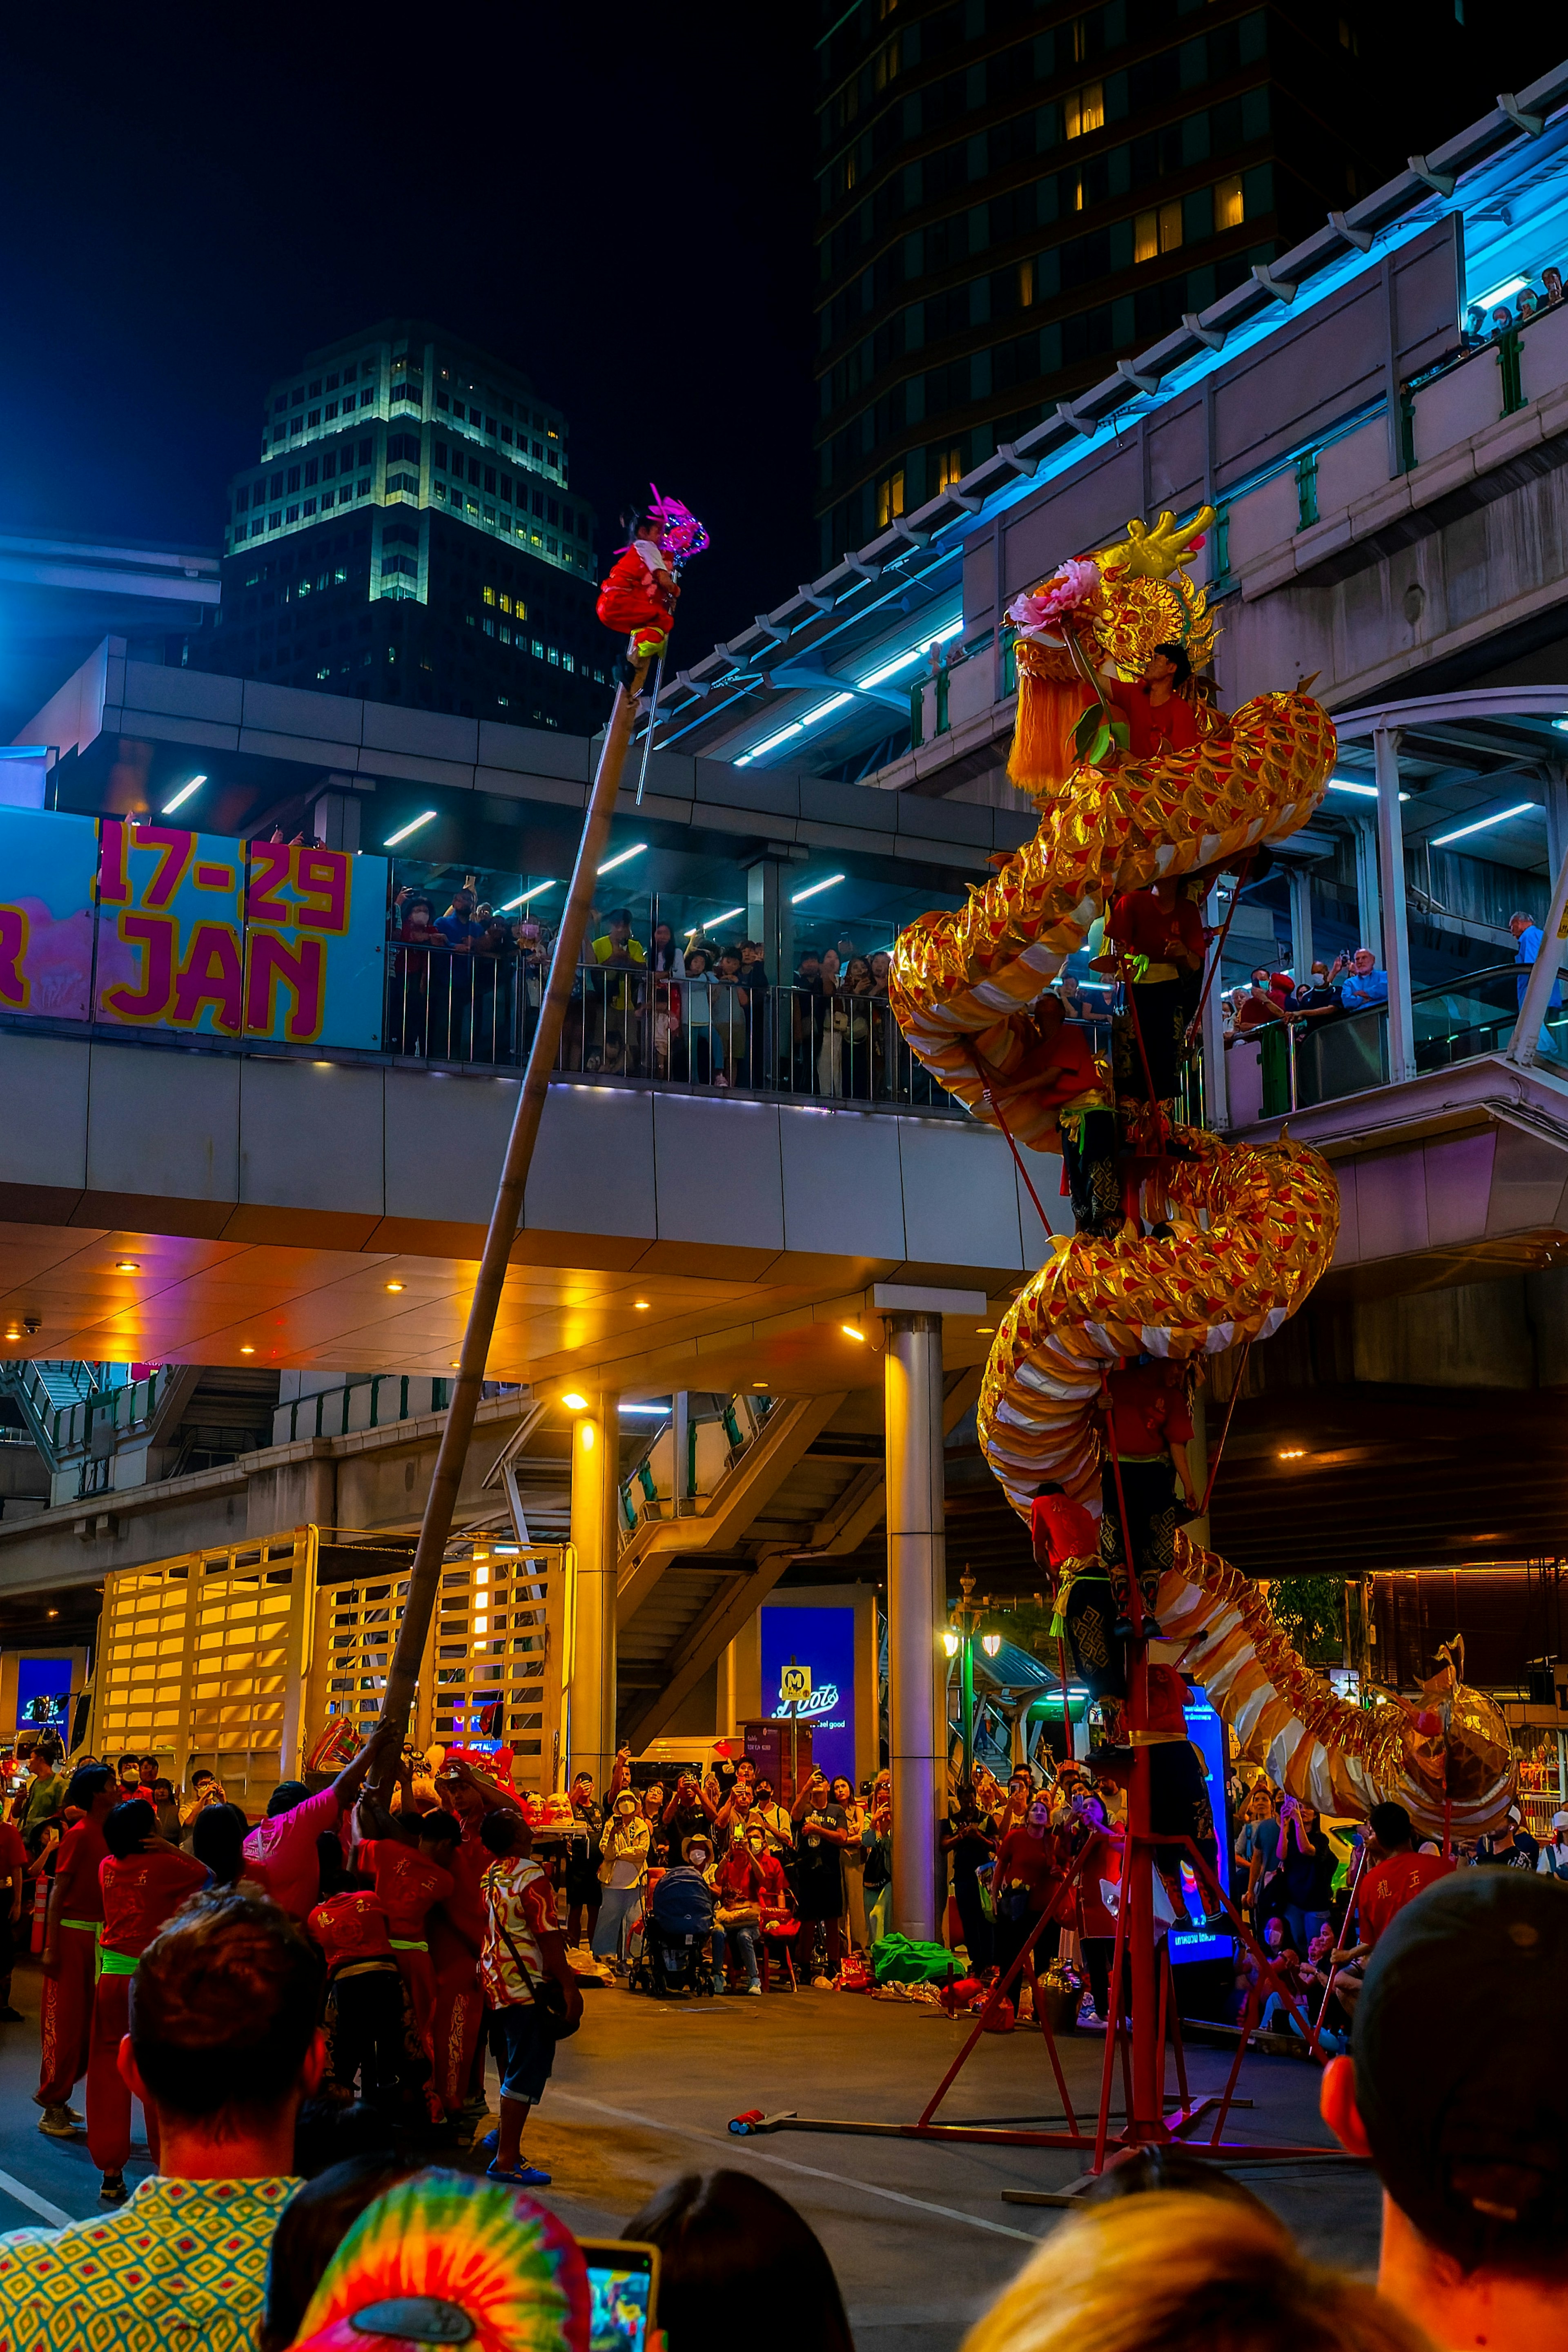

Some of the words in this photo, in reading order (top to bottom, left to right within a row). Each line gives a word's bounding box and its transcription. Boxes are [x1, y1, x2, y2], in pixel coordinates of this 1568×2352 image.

[92, 818, 351, 934] 17-29
[104, 911, 324, 1041] JAN
[829, 1720, 845, 1730] good
